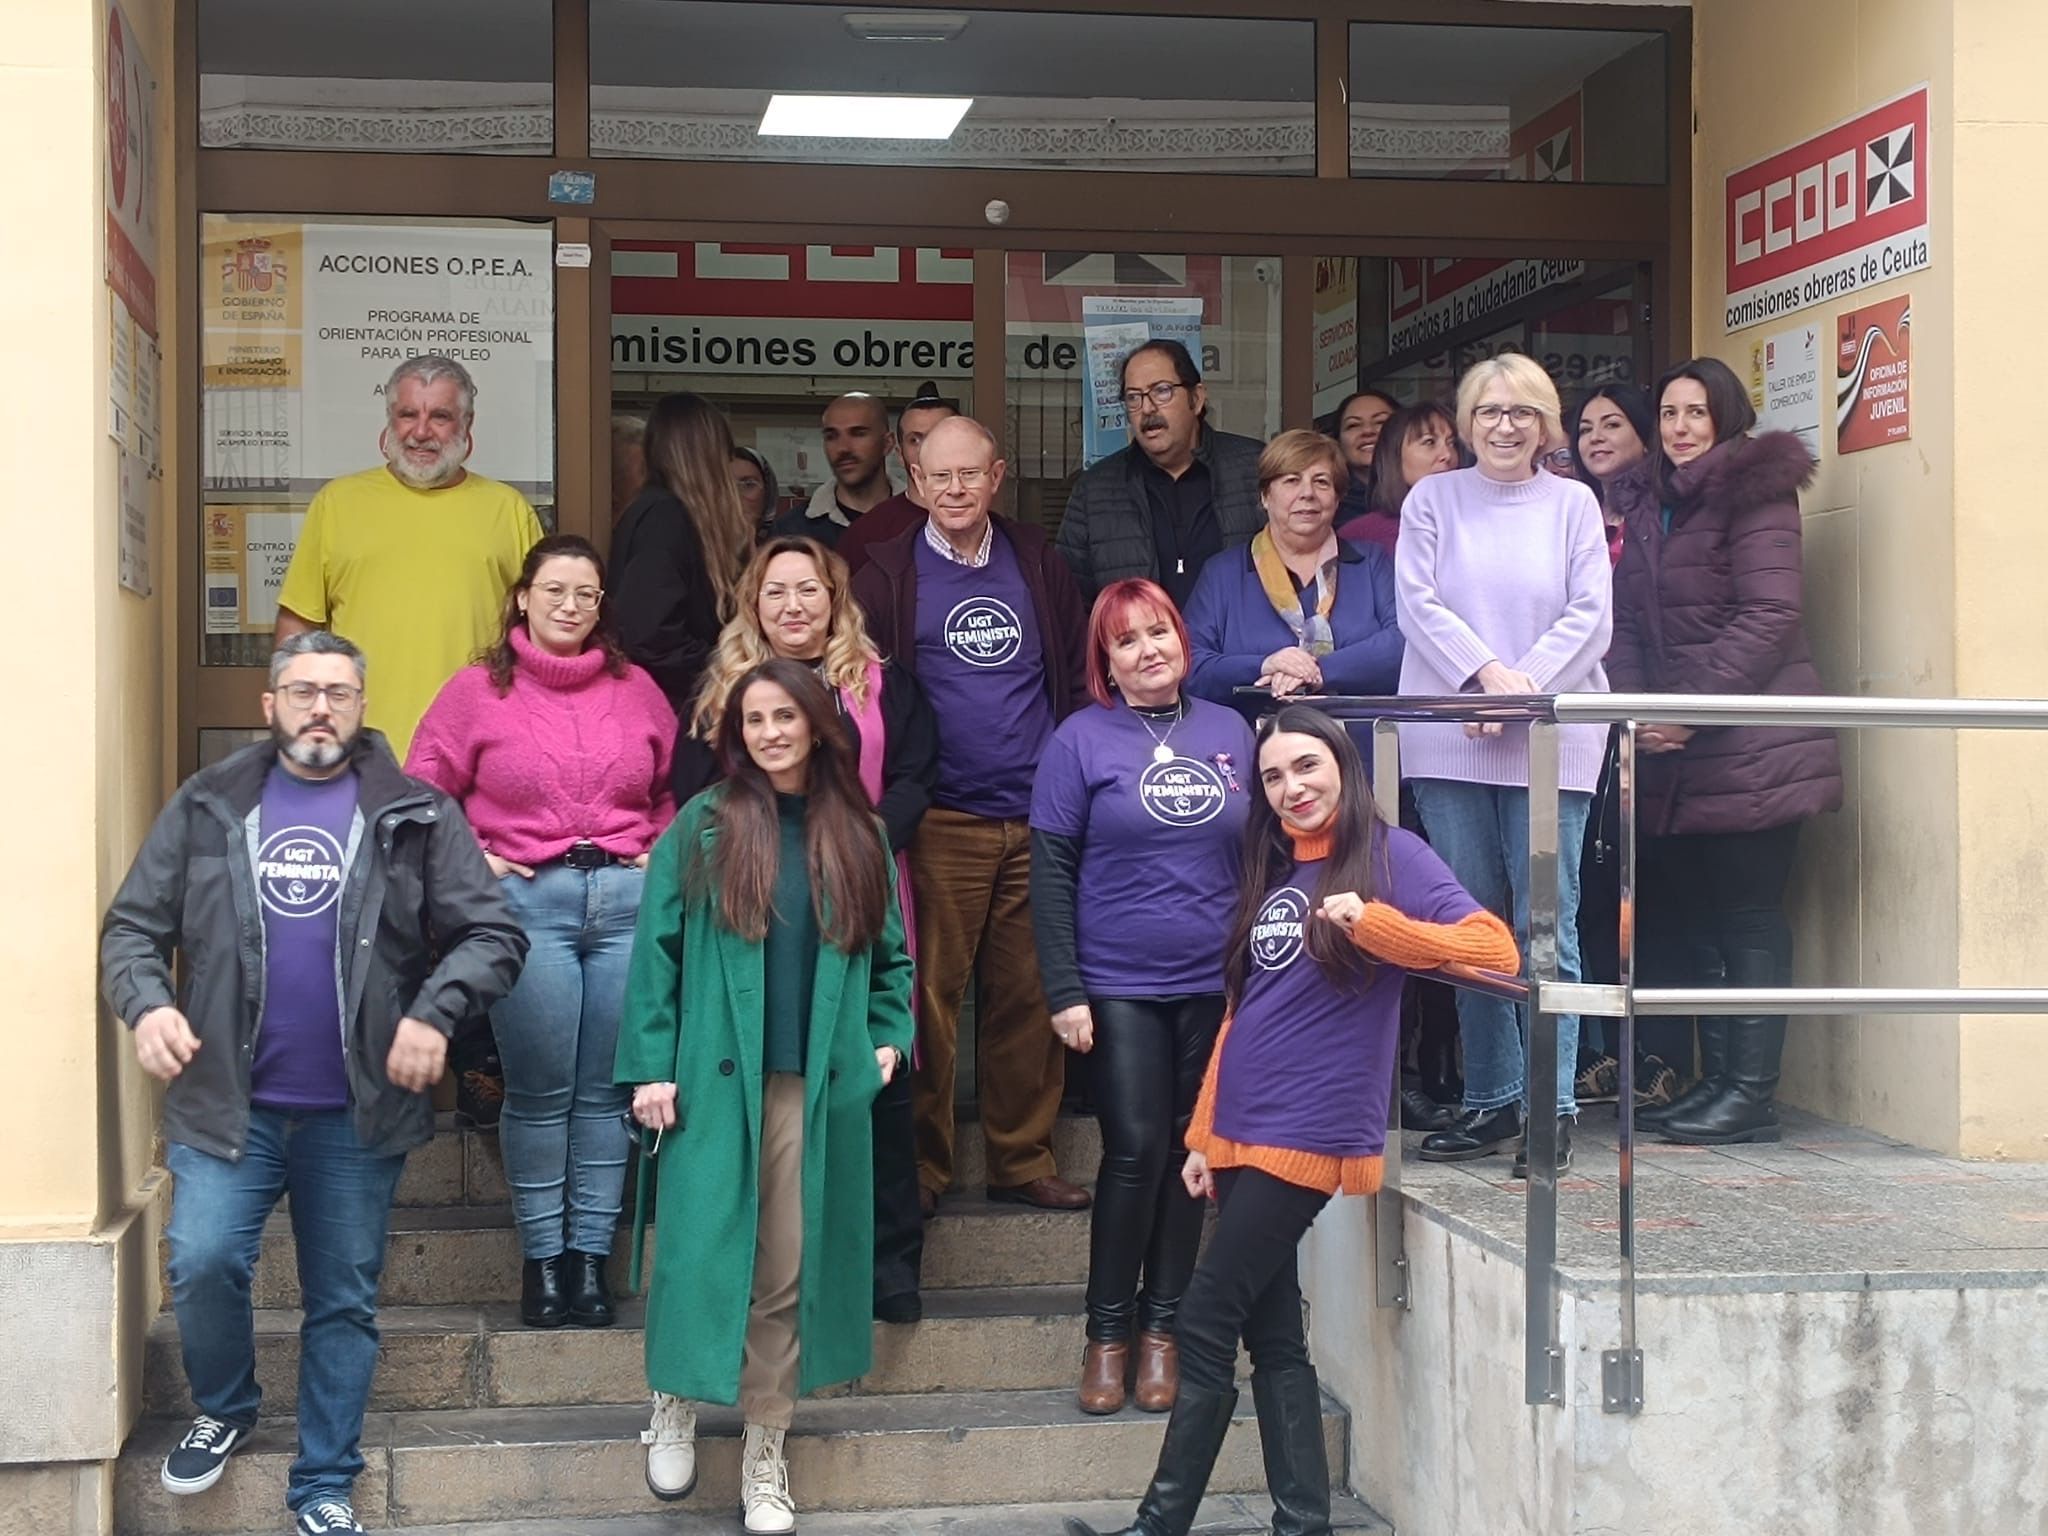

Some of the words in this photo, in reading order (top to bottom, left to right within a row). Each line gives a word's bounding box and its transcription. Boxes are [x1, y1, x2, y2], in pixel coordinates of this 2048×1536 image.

[1735, 148, 1857, 266] CCOO
[319, 255, 439, 274] ACCIONES
[447, 257, 533, 276] O.P.E.A.
[1726, 286, 1800, 327] comisiones
[1804, 266, 1856, 302] obreras
[1860, 254, 1877, 284] de
[1882, 239, 1927, 276] Ceuta
[222, 297, 285, 307] GOBIERNO
[222, 311, 238, 320] DE
[241, 309, 285, 320] ESPAÑA
[368, 310, 456, 323] PROGRAMA
[460, 312, 480, 324] DE
[1391, 310, 1440, 350] servicios
[1443, 307, 1450, 329] a
[1453, 296, 1463, 325] la
[319, 327, 423, 341] ORIENTACIÓN
[427, 330, 533, 343] PROFESIONAL
[1319, 318, 1354, 349] SERVICIOS
[228, 345, 281, 354] MINISTERIO
[361, 347, 401, 359] PARA
[406, 348, 421, 358] EL
[429, 348, 491, 360] EMPLEO
[611, 326, 817, 366] misiones
[833, 330, 974, 369] obrera
[1024, 335, 1077, 370] de
[241, 357, 284, 366] TRABAJO
[218, 367, 224, 375] E
[226, 366, 291, 376] INMIGRACIÓN
[1870, 363, 1897, 381] OFICINA
[1897, 360, 1907, 373] DE
[1863, 376, 1907, 400] INFORMACIÓN
[1870, 397, 1907, 420] JUVENIL
[247, 543, 286, 551] CENTRO
[289, 542, 296, 551] D
[265, 555, 272, 563] Y
[264, 579, 283, 587] PAR
[968, 615, 992, 628] UGT
[948, 626, 1019, 644] FEMINISTA
[1165, 773, 1191, 784] UGT
[1144, 784, 1221, 797] FEMINISTA
[285, 848, 315, 861] UGT
[259, 861, 340, 881] FEMINISTA
[1268, 907, 1289, 921] UGT
